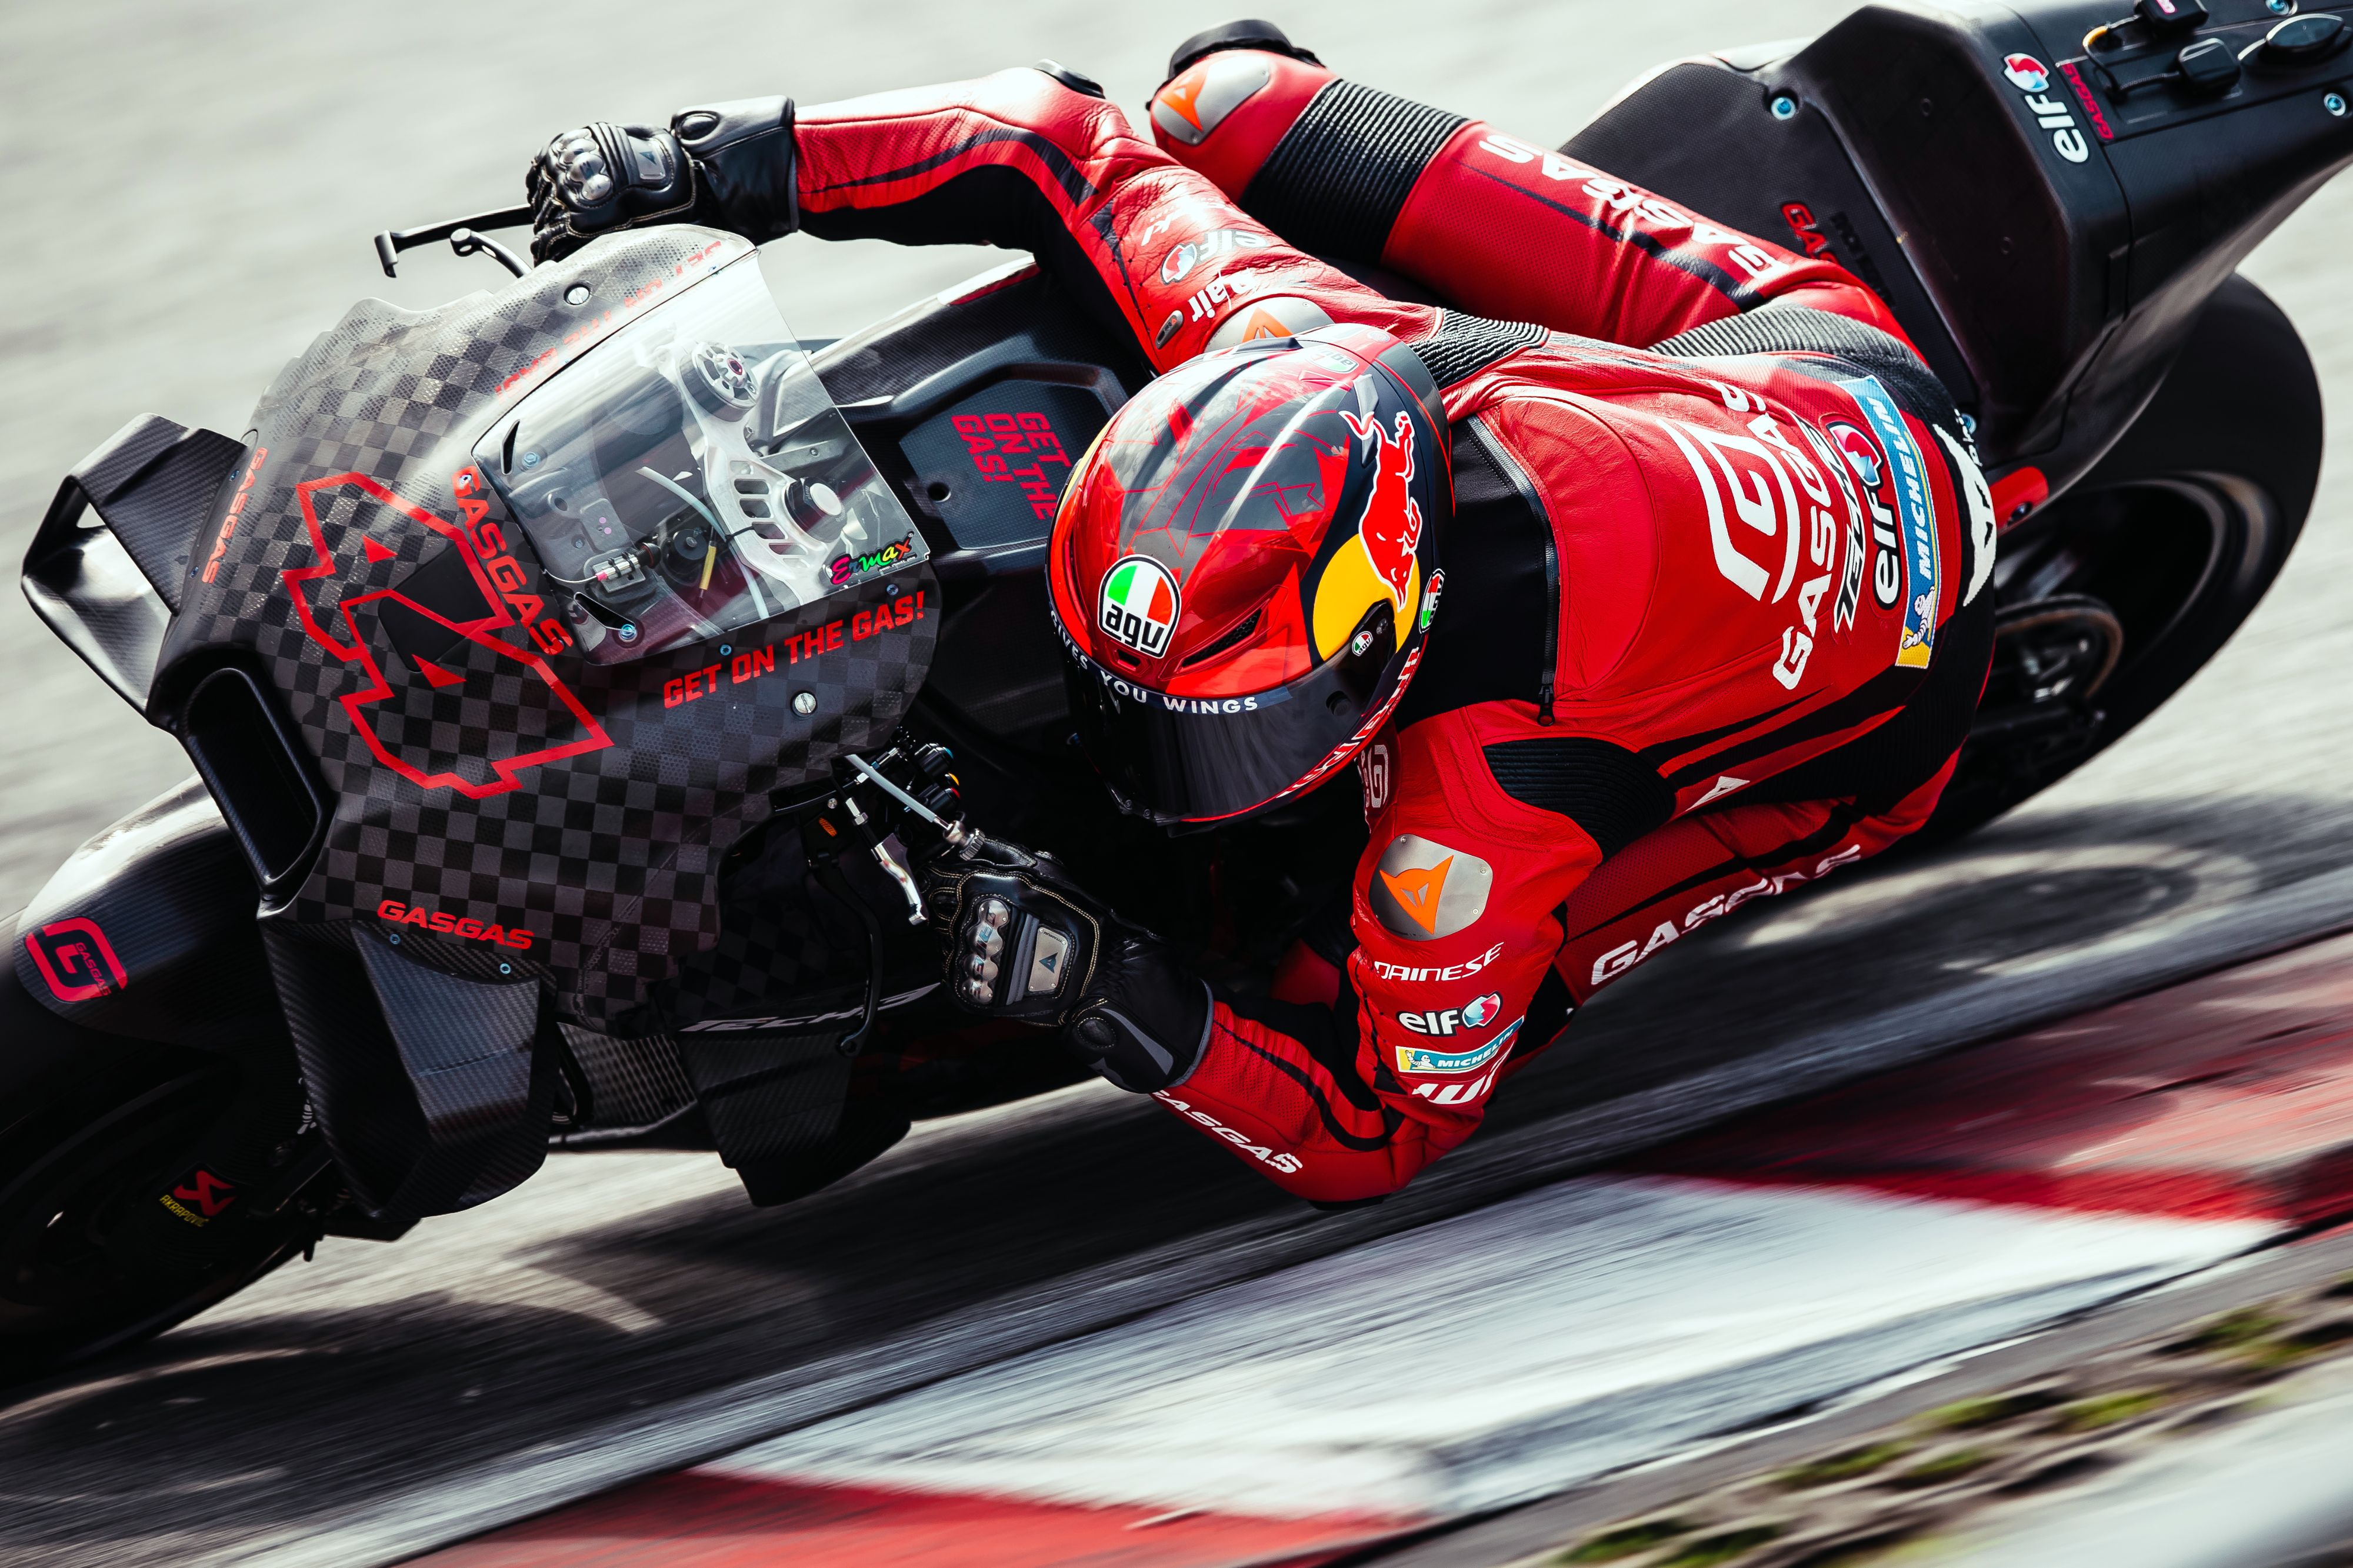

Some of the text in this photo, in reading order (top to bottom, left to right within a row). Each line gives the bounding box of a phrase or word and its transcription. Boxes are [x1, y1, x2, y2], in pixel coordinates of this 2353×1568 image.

[2025, 95, 2088, 162] elf
[1479, 134, 1791, 279] GASGAS
[1199, 229, 1267, 261] elf
[951, 415, 1015, 482] GAS!
[984, 413, 1058, 520] ON THE
[1016, 412, 1072, 468] GET
[202, 447, 268, 583] GASGAS
[1866, 396, 1932, 579] MICHELIN
[452, 465, 574, 656] GASGAS
[1863, 486, 1899, 604] elf
[664, 591, 925, 709] GET ON THE GAS!
[1105, 603, 1165, 649] agv
[1051, 610, 1258, 715] GIVES YOU WINGS
[376, 899, 535, 950] GASGAS
[75, 942, 112, 996] GASGAS
[1374, 942, 1504, 982] DAINESE
[1398, 1009, 1464, 1035] elf
[1438, 1028, 1514, 1068] MICHELIN
